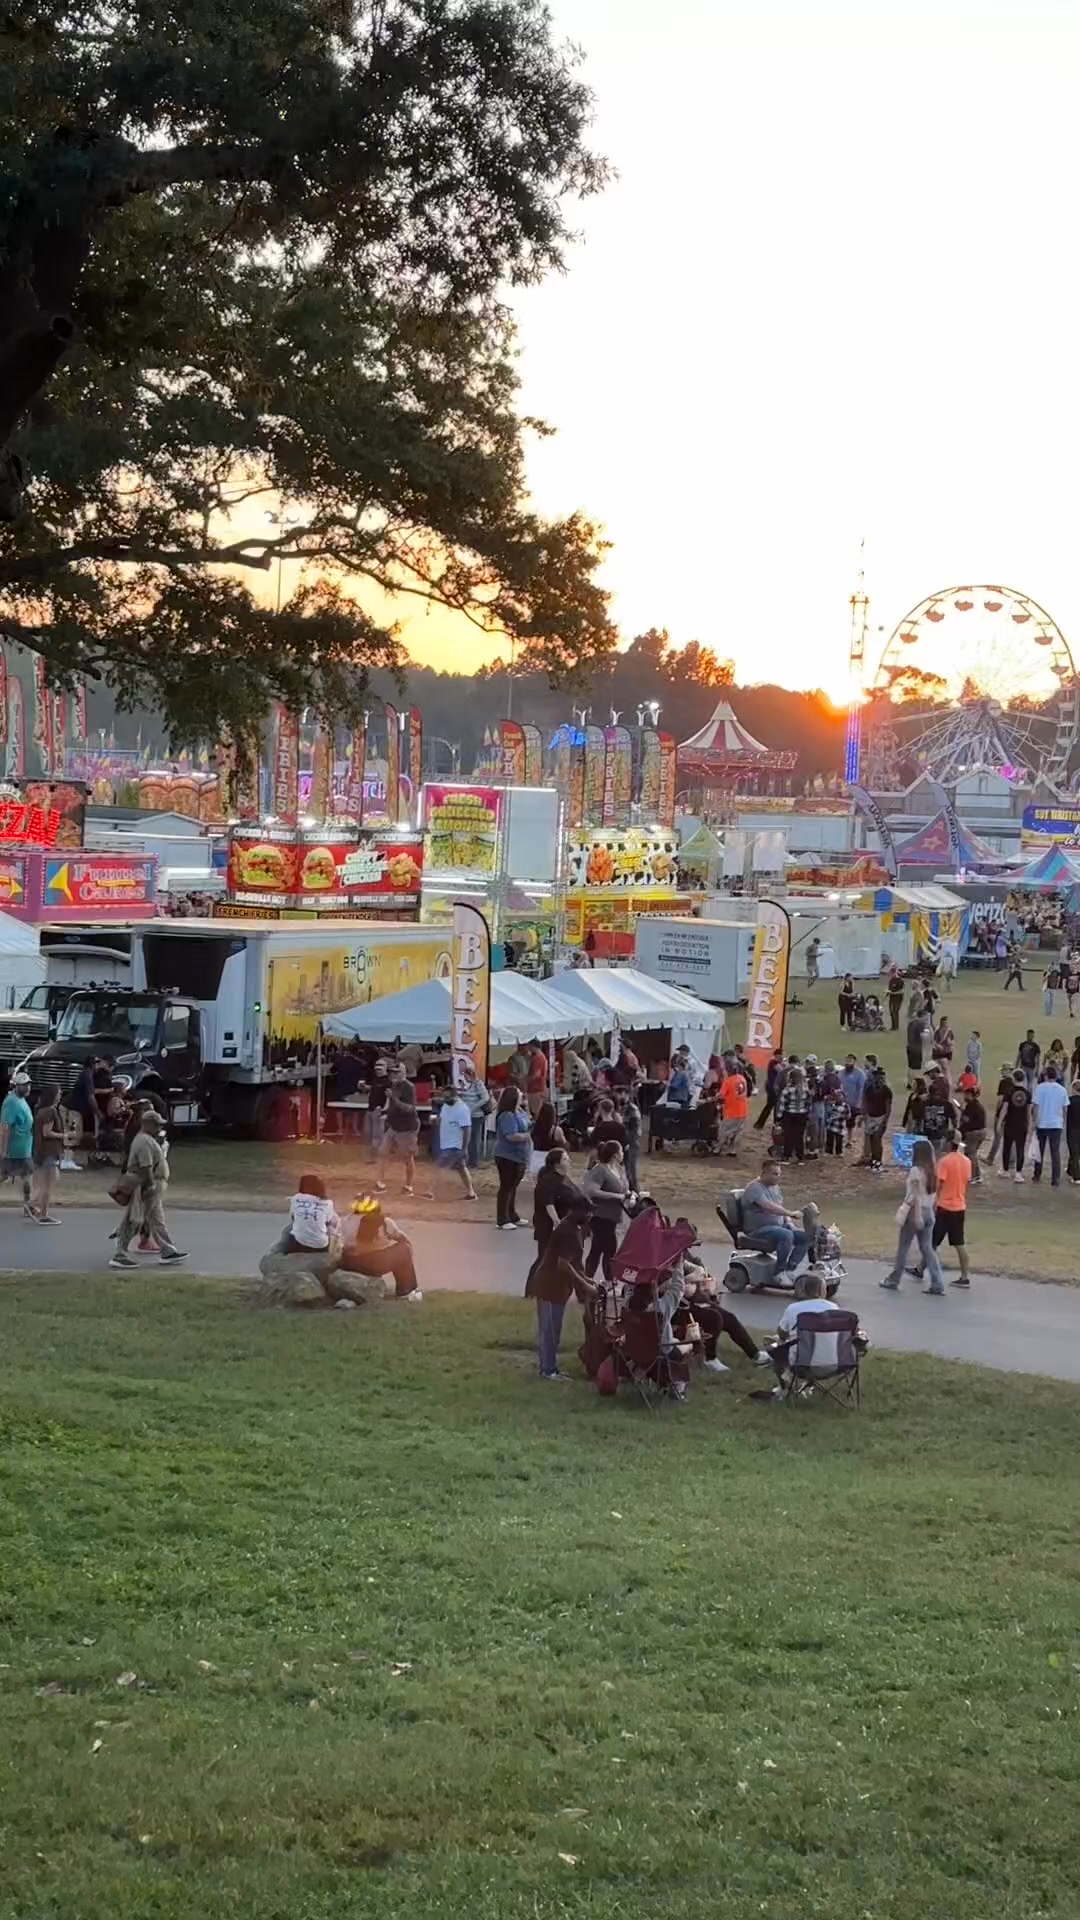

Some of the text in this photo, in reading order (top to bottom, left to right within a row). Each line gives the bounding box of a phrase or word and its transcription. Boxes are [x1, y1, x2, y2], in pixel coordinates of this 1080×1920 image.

[603, 752, 616, 818] FRIES
[451, 932, 486, 1090] BEER
[746, 922, 785, 1050] BEER
